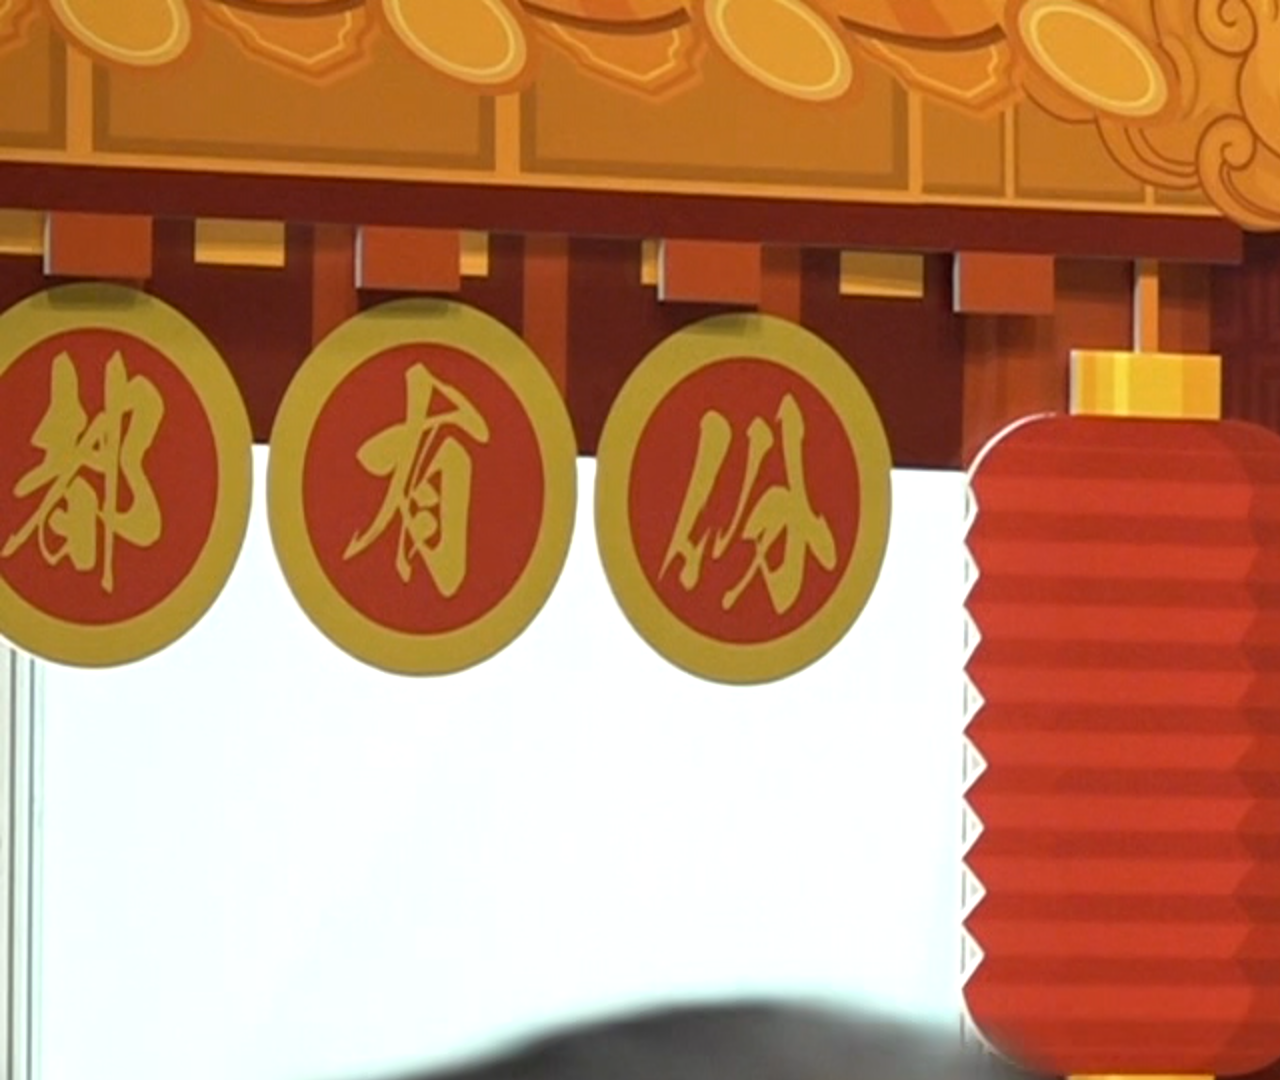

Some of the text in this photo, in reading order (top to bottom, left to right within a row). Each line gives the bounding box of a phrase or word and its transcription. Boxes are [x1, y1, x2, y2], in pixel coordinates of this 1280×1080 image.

[1, 350, 837, 614] 都 有 份
